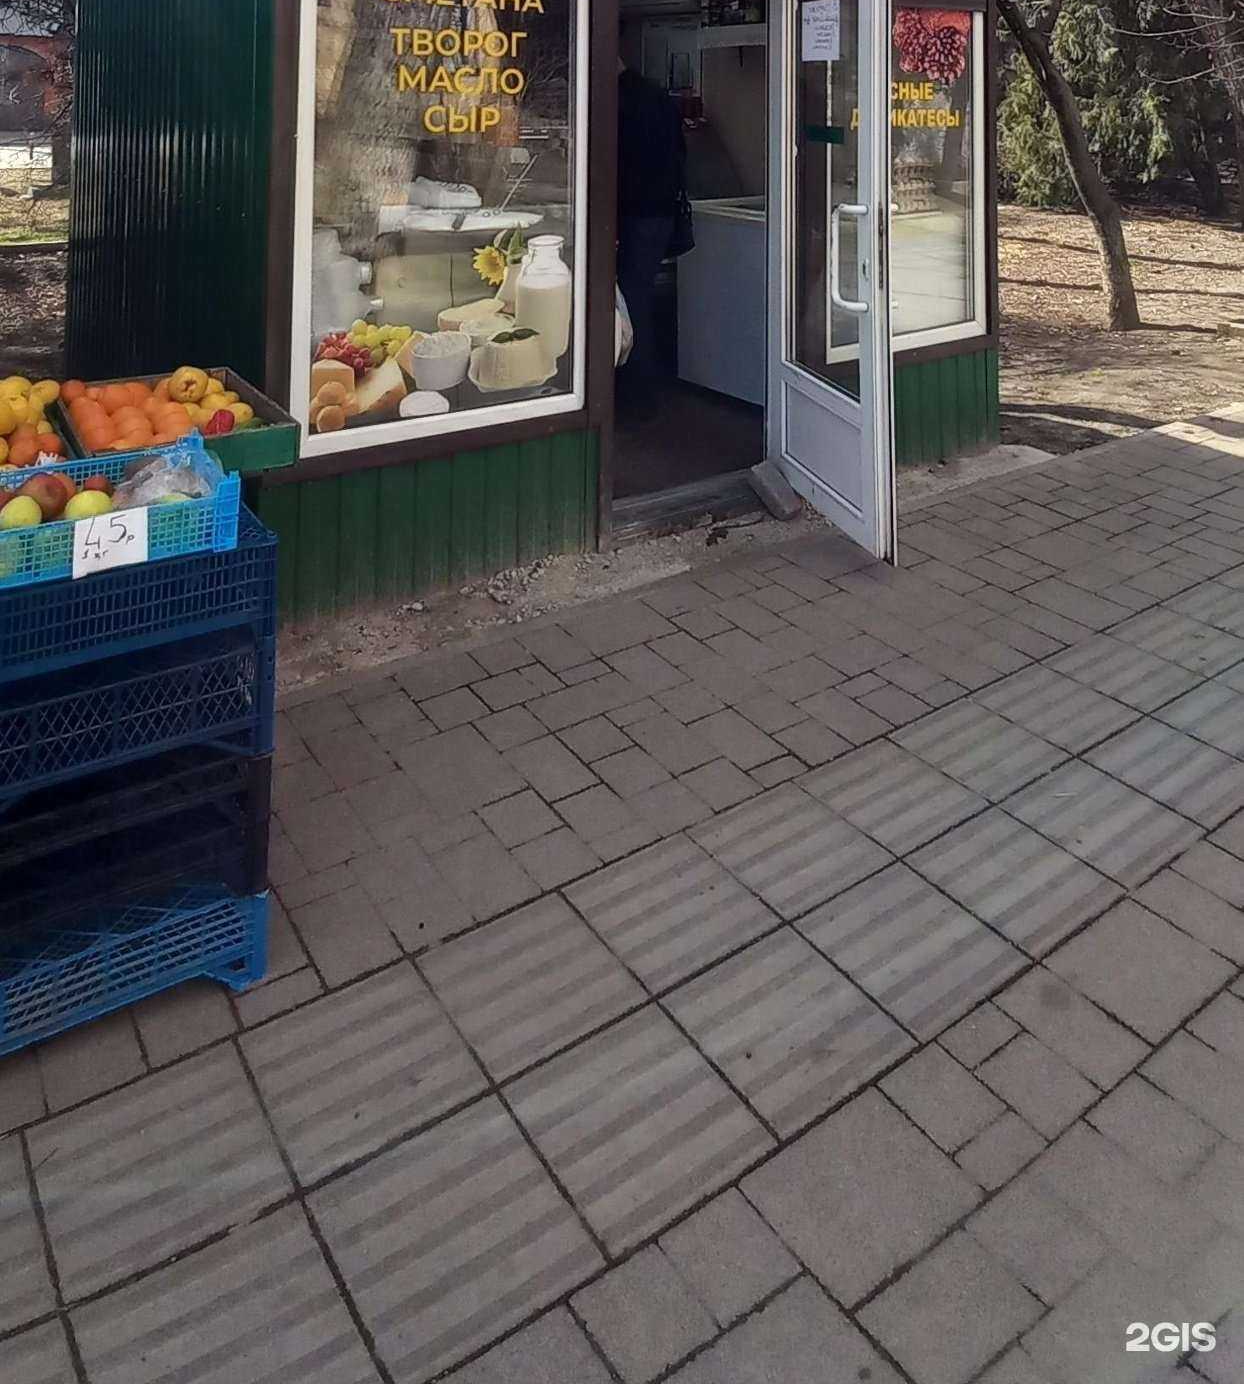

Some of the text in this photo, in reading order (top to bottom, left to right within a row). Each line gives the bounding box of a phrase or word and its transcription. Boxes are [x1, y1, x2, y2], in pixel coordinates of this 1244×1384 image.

[389, 27, 527, 58] ТВОРОГ
[397, 65, 524, 95] МАСЛО
[891, 81, 934, 100] СНЫЕ
[423, 105, 501, 133] СЫР
